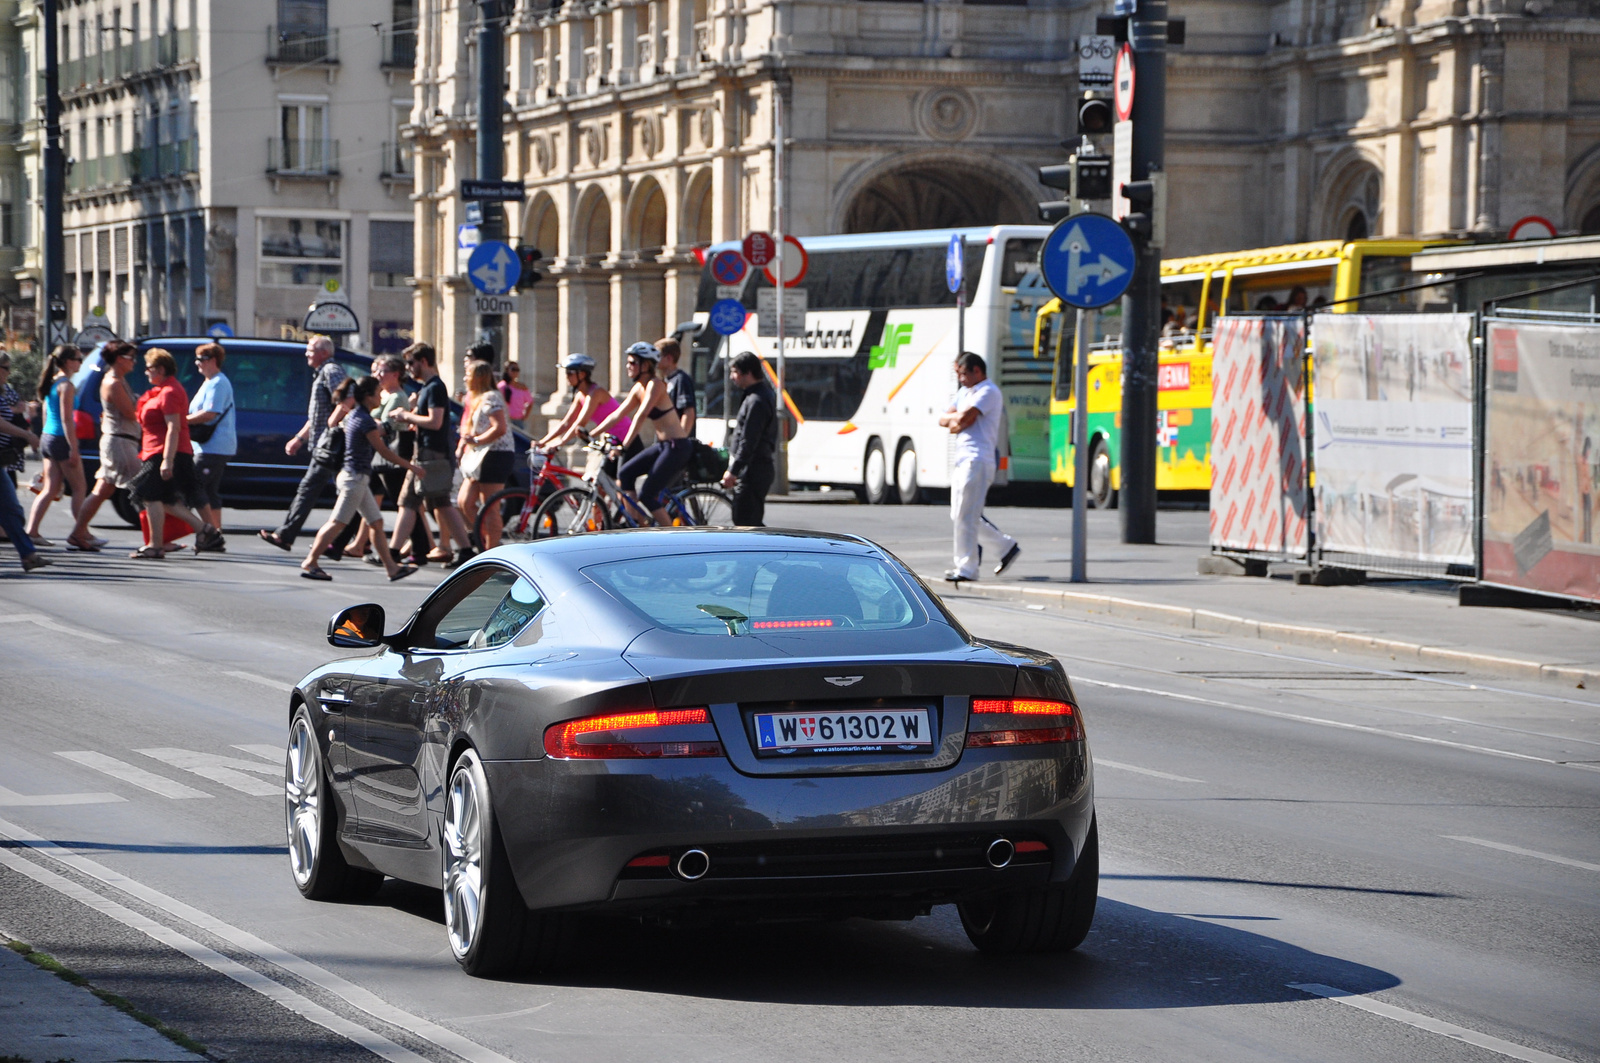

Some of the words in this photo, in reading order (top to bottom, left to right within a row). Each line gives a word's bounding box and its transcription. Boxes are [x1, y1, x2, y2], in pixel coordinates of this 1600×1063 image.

[752, 233, 767, 263] STOP
[475, 297, 513, 312] 100m
[778, 717, 797, 742] W
[813, 745, 882, 753] www.astonmartin-wien.at
